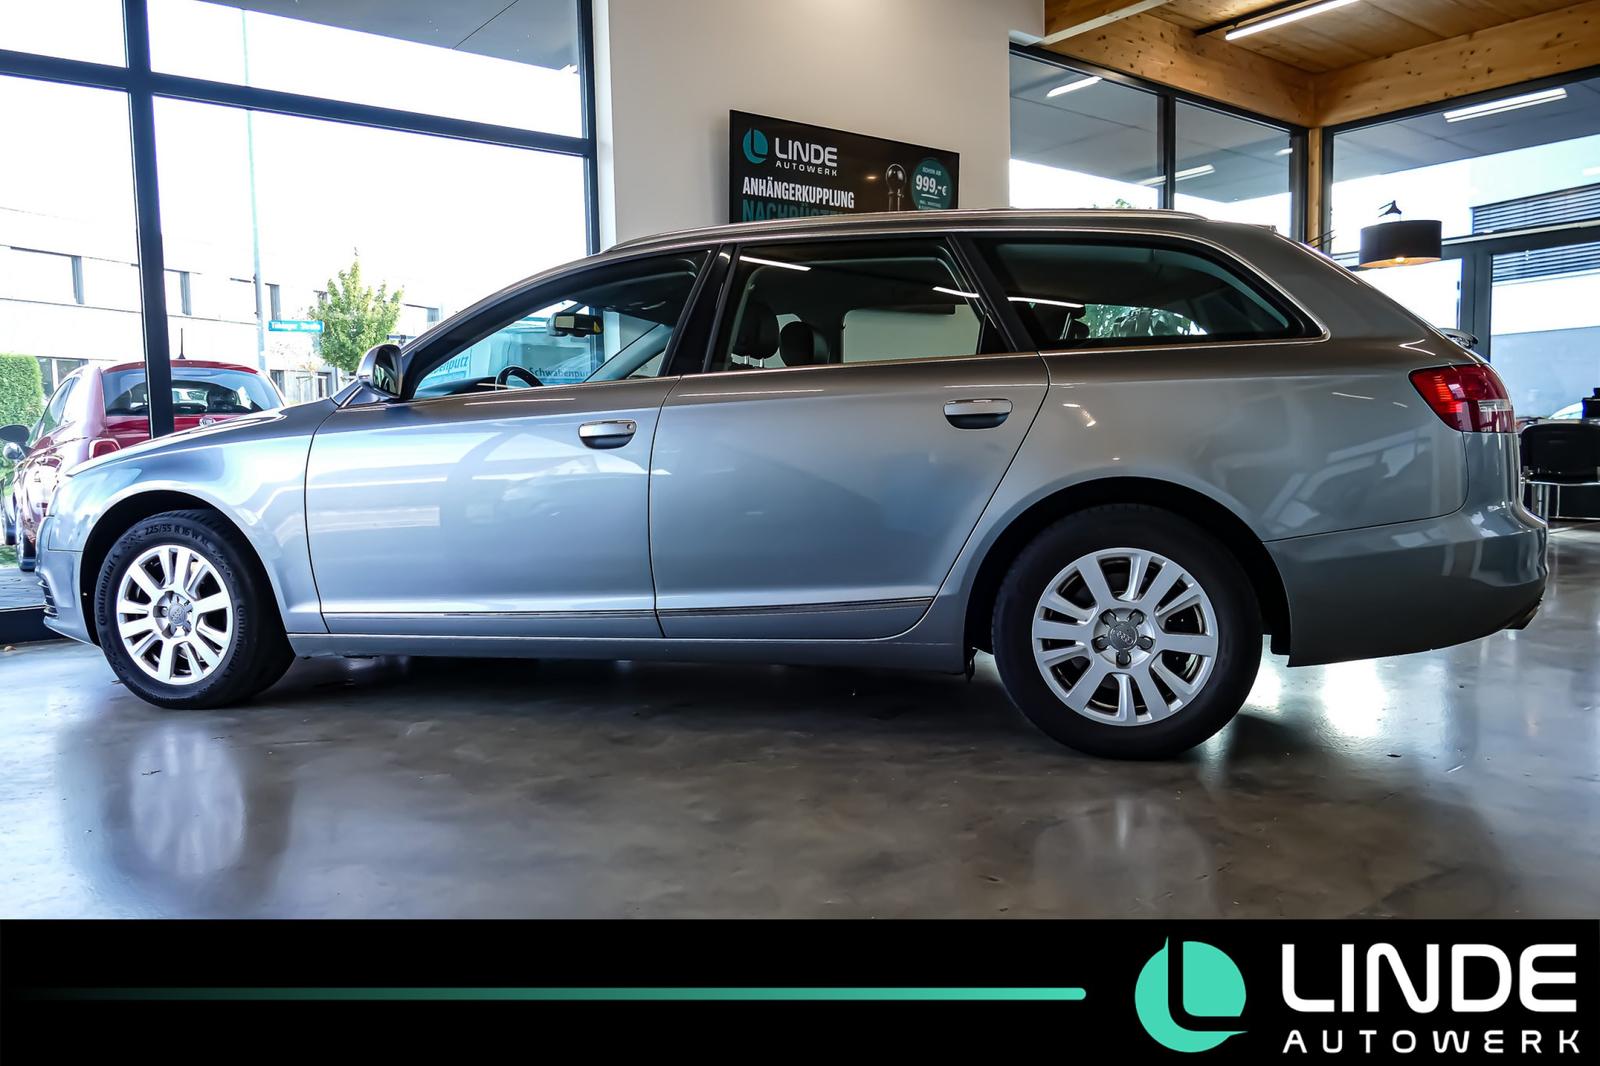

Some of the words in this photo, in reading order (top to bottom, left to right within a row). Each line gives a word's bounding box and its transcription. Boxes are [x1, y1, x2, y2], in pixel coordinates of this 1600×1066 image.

[775, 137, 838, 168] LINDE
[776, 160, 838, 176] AUTOWERK
[742, 176, 855, 209] ANHÄNGERKUPPLUNG
